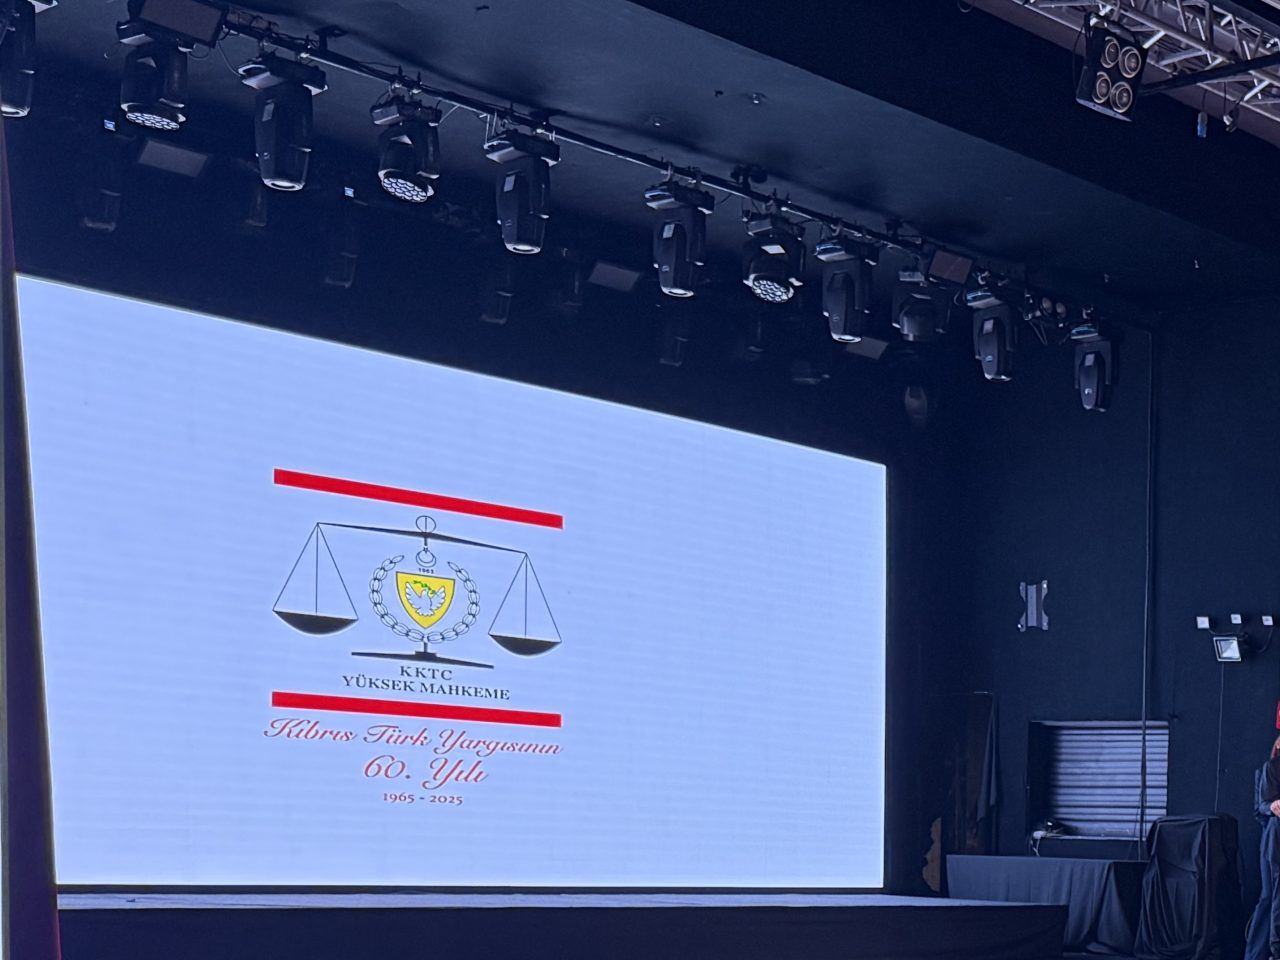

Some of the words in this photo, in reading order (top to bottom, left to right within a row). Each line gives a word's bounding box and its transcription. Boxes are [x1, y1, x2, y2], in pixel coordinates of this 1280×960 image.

[400, 665, 453, 681] KKTC
[342, 674, 415, 692] YÜKSEK
[420, 682, 510, 701] MAHKEME
[263, 717, 358, 742] Kıbrıs
[363, 724, 433, 746] Türk
[363, 754, 411, 779] 60.
[422, 756, 489, 790] Yılı
[383, 792, 415, 804] 1965
[430, 794, 464, 806] 2025
